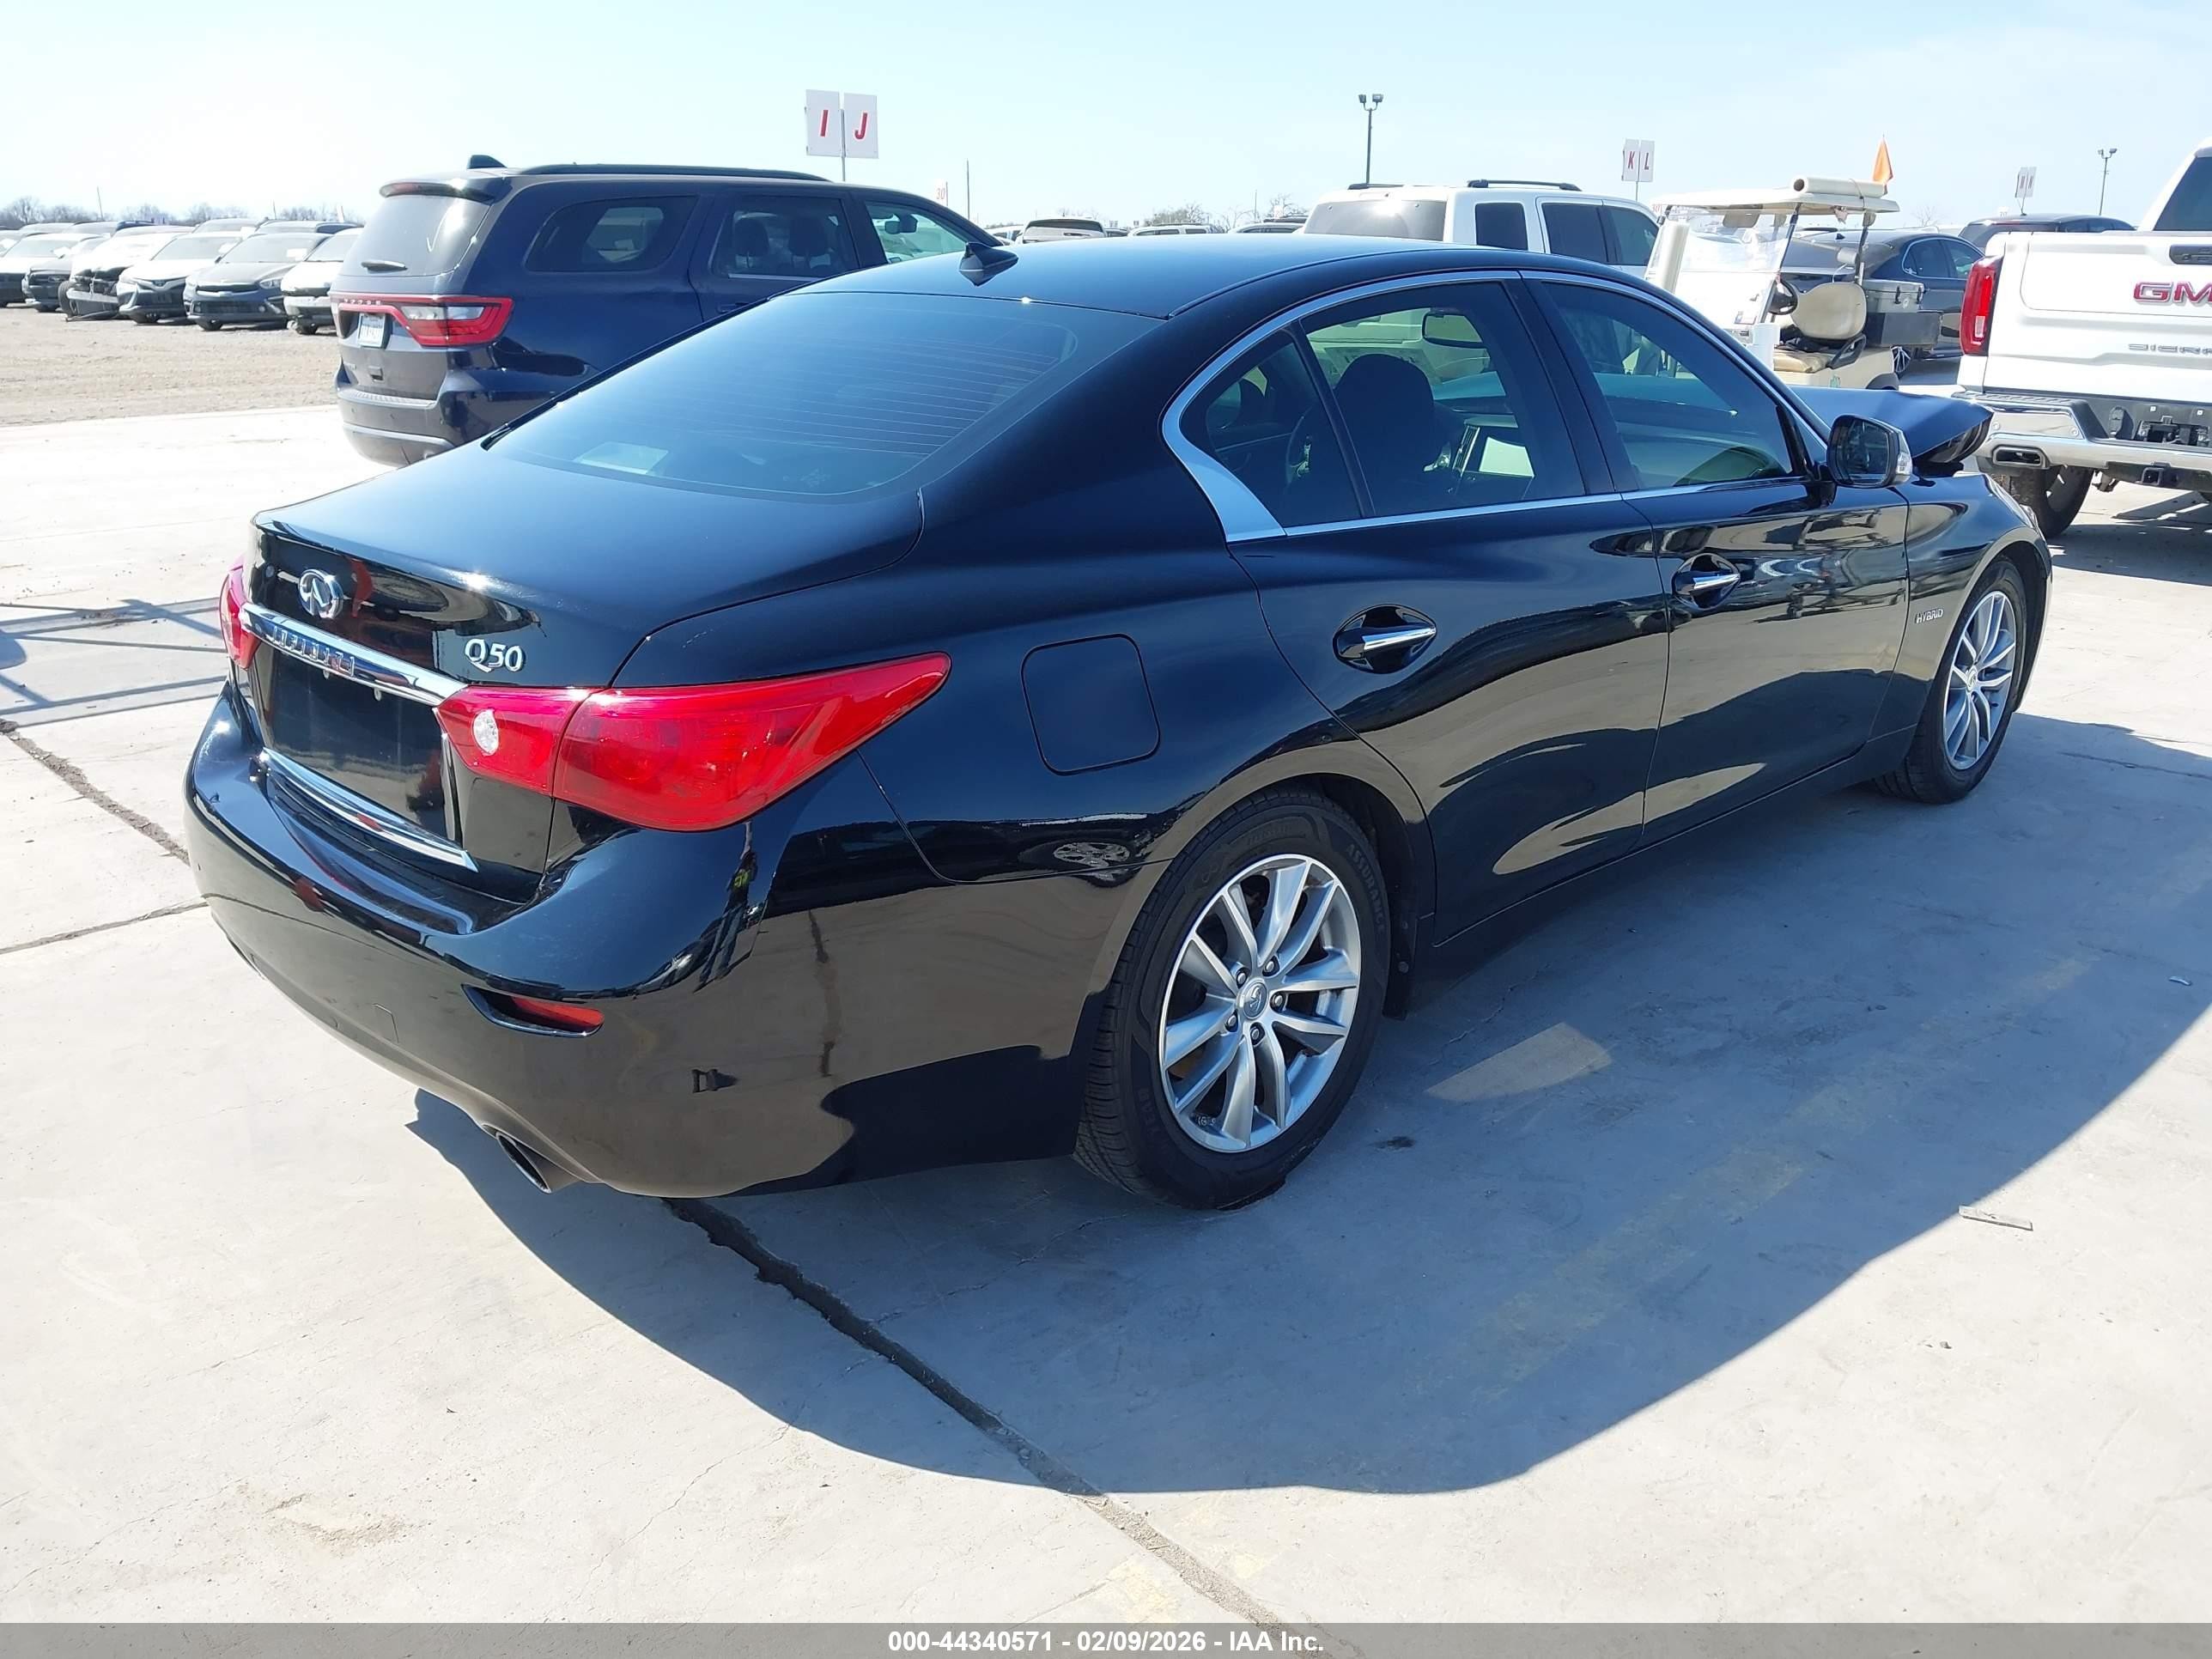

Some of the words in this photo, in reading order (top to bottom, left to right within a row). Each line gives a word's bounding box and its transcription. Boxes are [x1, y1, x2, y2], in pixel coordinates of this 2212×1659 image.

[819, 109, 829, 137] I
[854, 112, 868, 140] J
[1627, 150, 1636, 170] K
[1644, 152, 1650, 170] L
[1915, 608, 1944, 624] HYBRID
[465, 638, 524, 673] Q50
[1346, 843, 1386, 933] ASSURANCE
